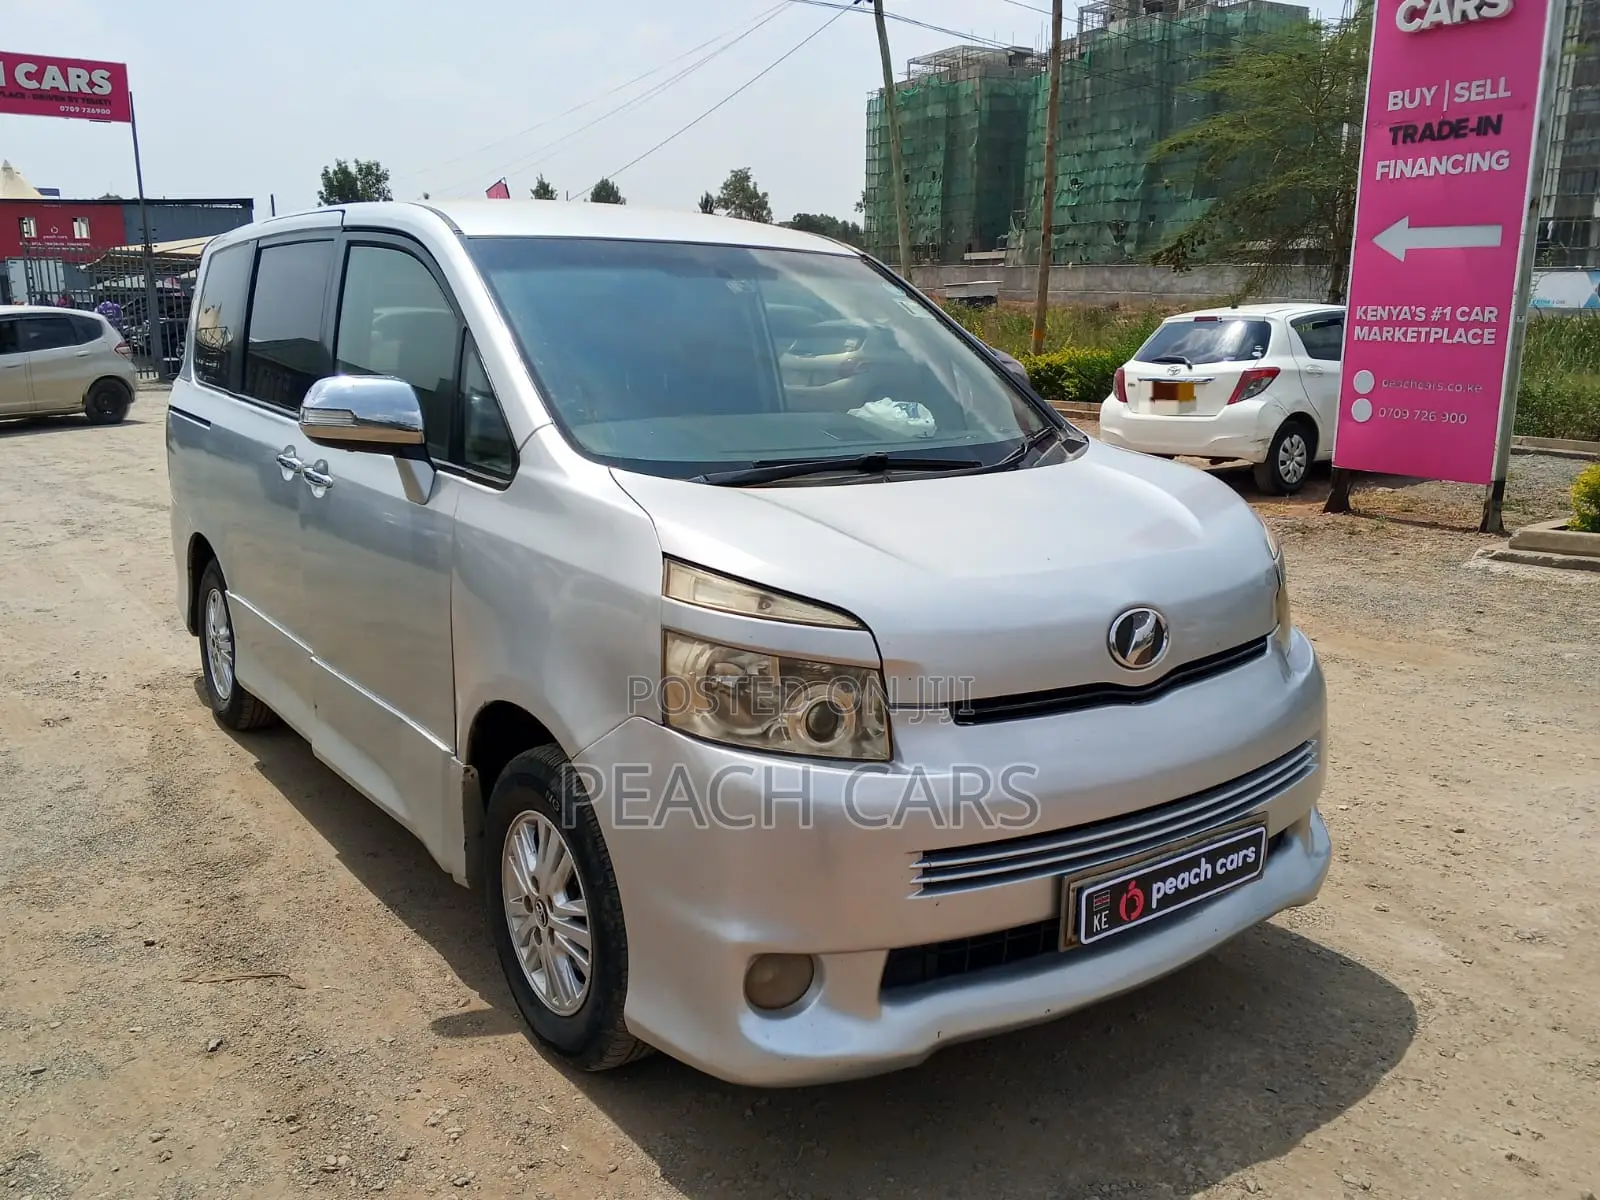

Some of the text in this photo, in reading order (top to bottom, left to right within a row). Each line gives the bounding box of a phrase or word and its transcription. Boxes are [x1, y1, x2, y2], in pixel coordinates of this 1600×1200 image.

[1396, 0, 1514, 32] CARS
[14, 62, 112, 95] CARS
[1387, 77, 1511, 111] BUY SELL
[60, 105, 111, 115] 0709 726900
[1389, 114, 1503, 145] TRADE-IN
[1376, 150, 1510, 180] FINANCING
[1356, 305, 1498, 322] KENYA'S #1 CAR
[1354, 326, 1496, 345] MARKETPLACE
[1379, 407, 1409, 420] 0709
[1414, 409, 1437, 422] 726
[1093, 846, 1256, 932] KE peach cars
